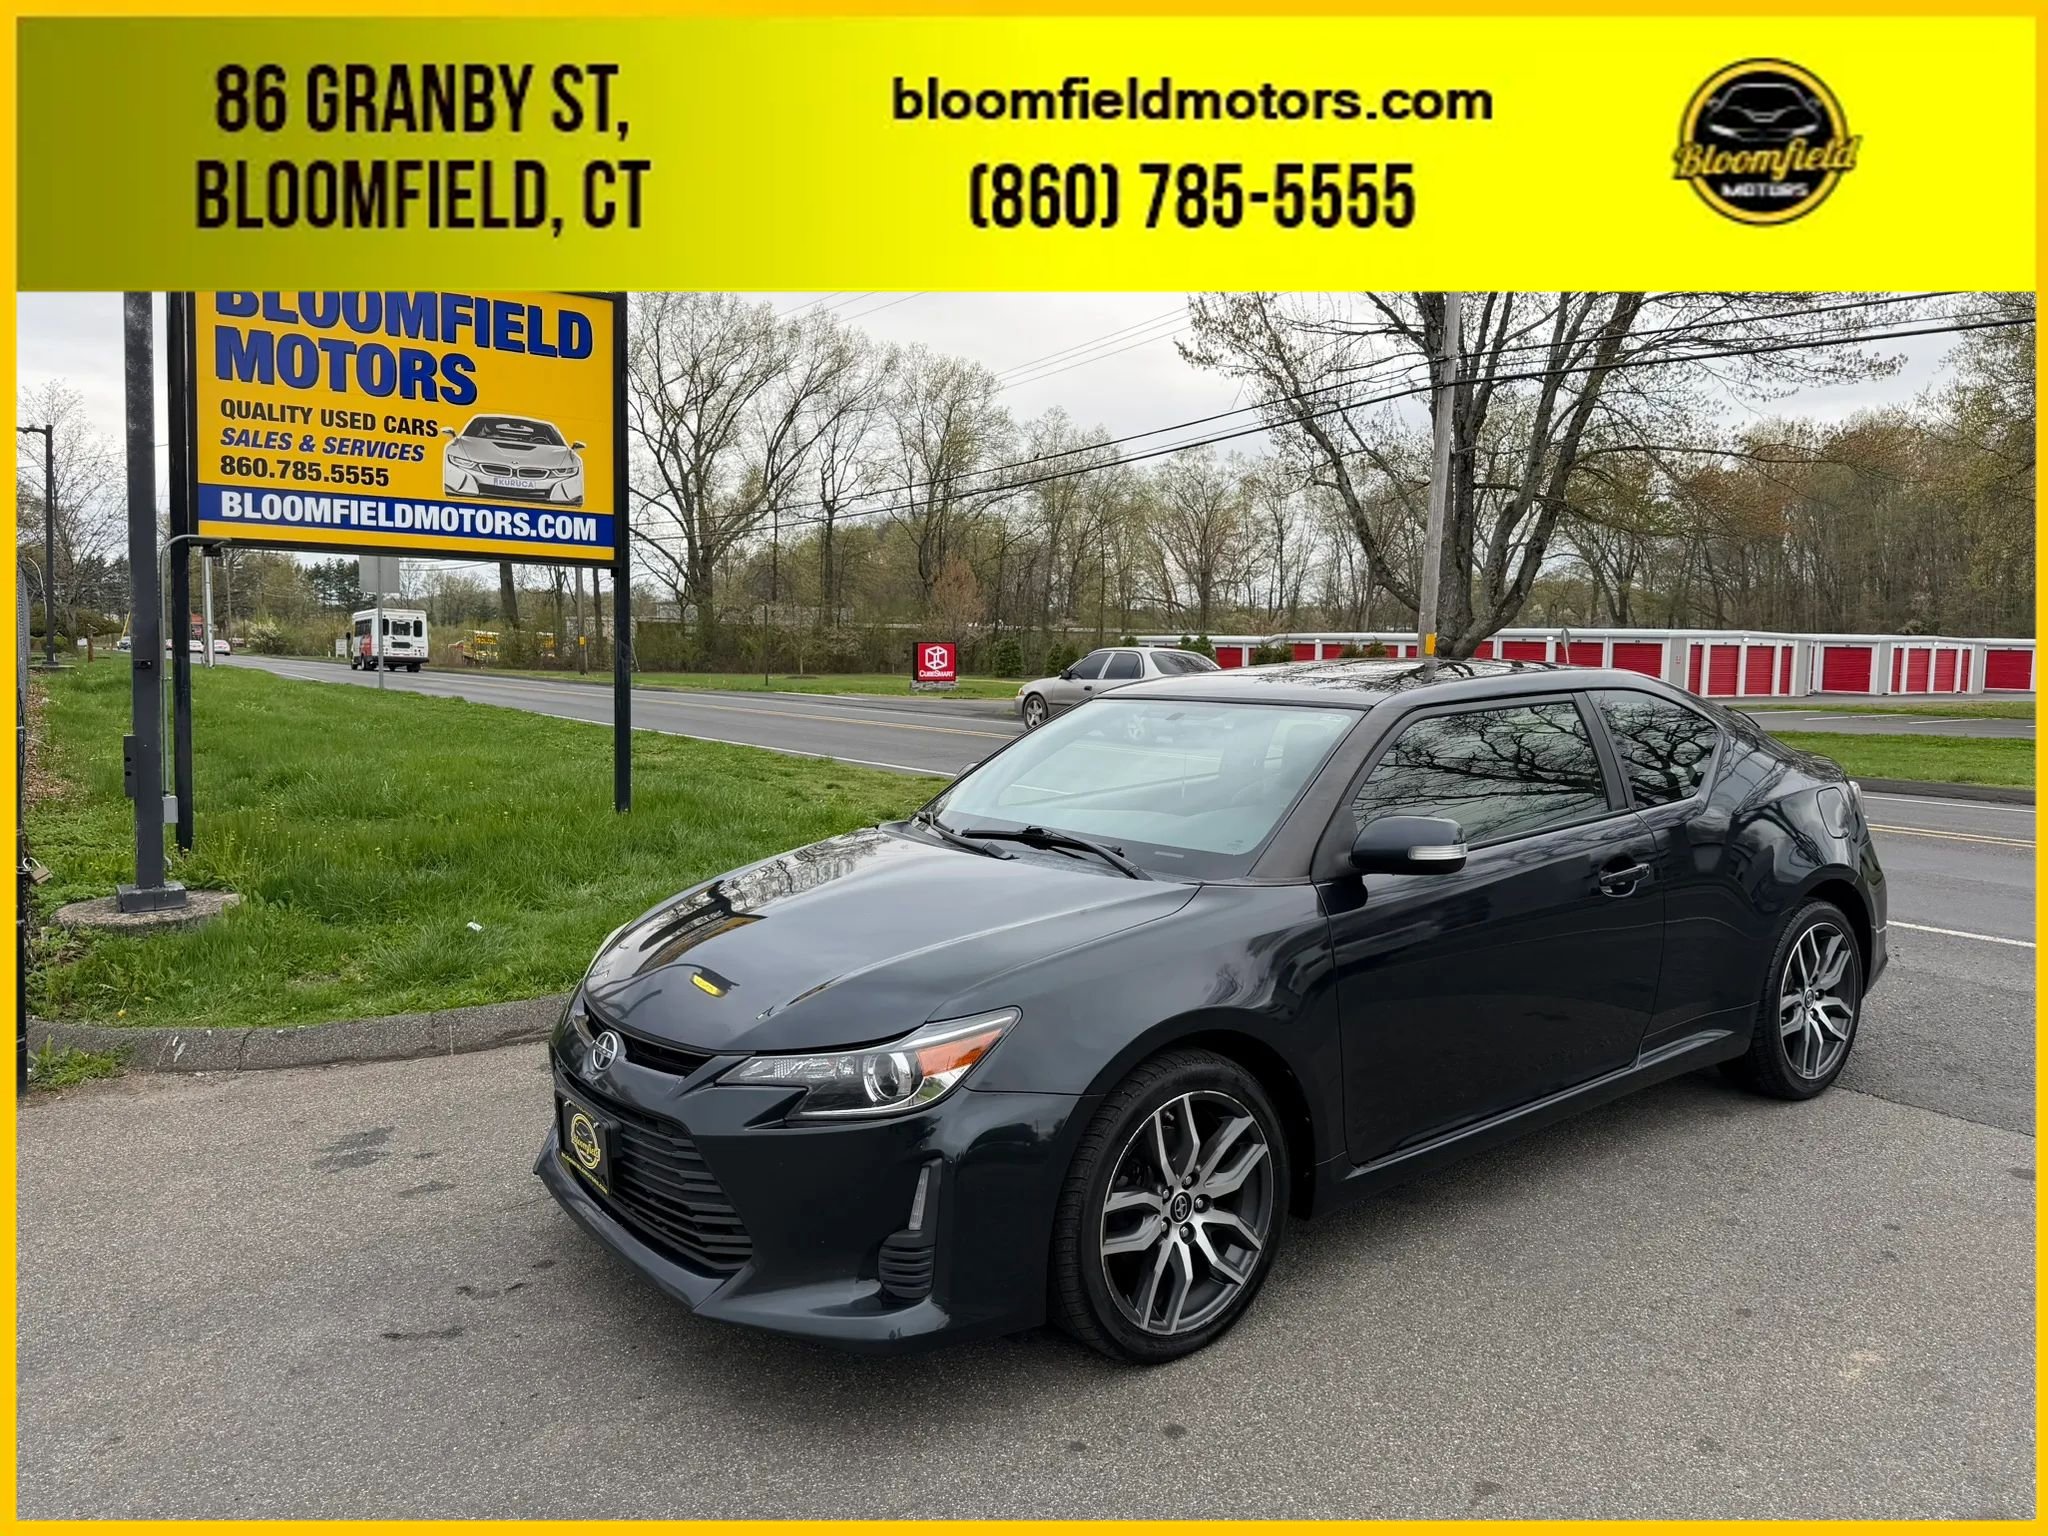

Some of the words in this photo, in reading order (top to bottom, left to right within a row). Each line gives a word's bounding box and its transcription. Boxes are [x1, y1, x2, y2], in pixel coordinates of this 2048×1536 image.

[215, 324, 478, 406] MOTORS
[220, 398, 313, 425] QUALITY
[320, 408, 376, 432] USED
[383, 415, 439, 437] CARS
[220, 427, 293, 451] SALES
[298, 434, 316, 452] &
[322, 436, 425, 462] SERVICES
[220, 455, 389, 487] 860.785.5555
[221, 492, 597, 542] BLOOMFIELDMOTORS.COM
